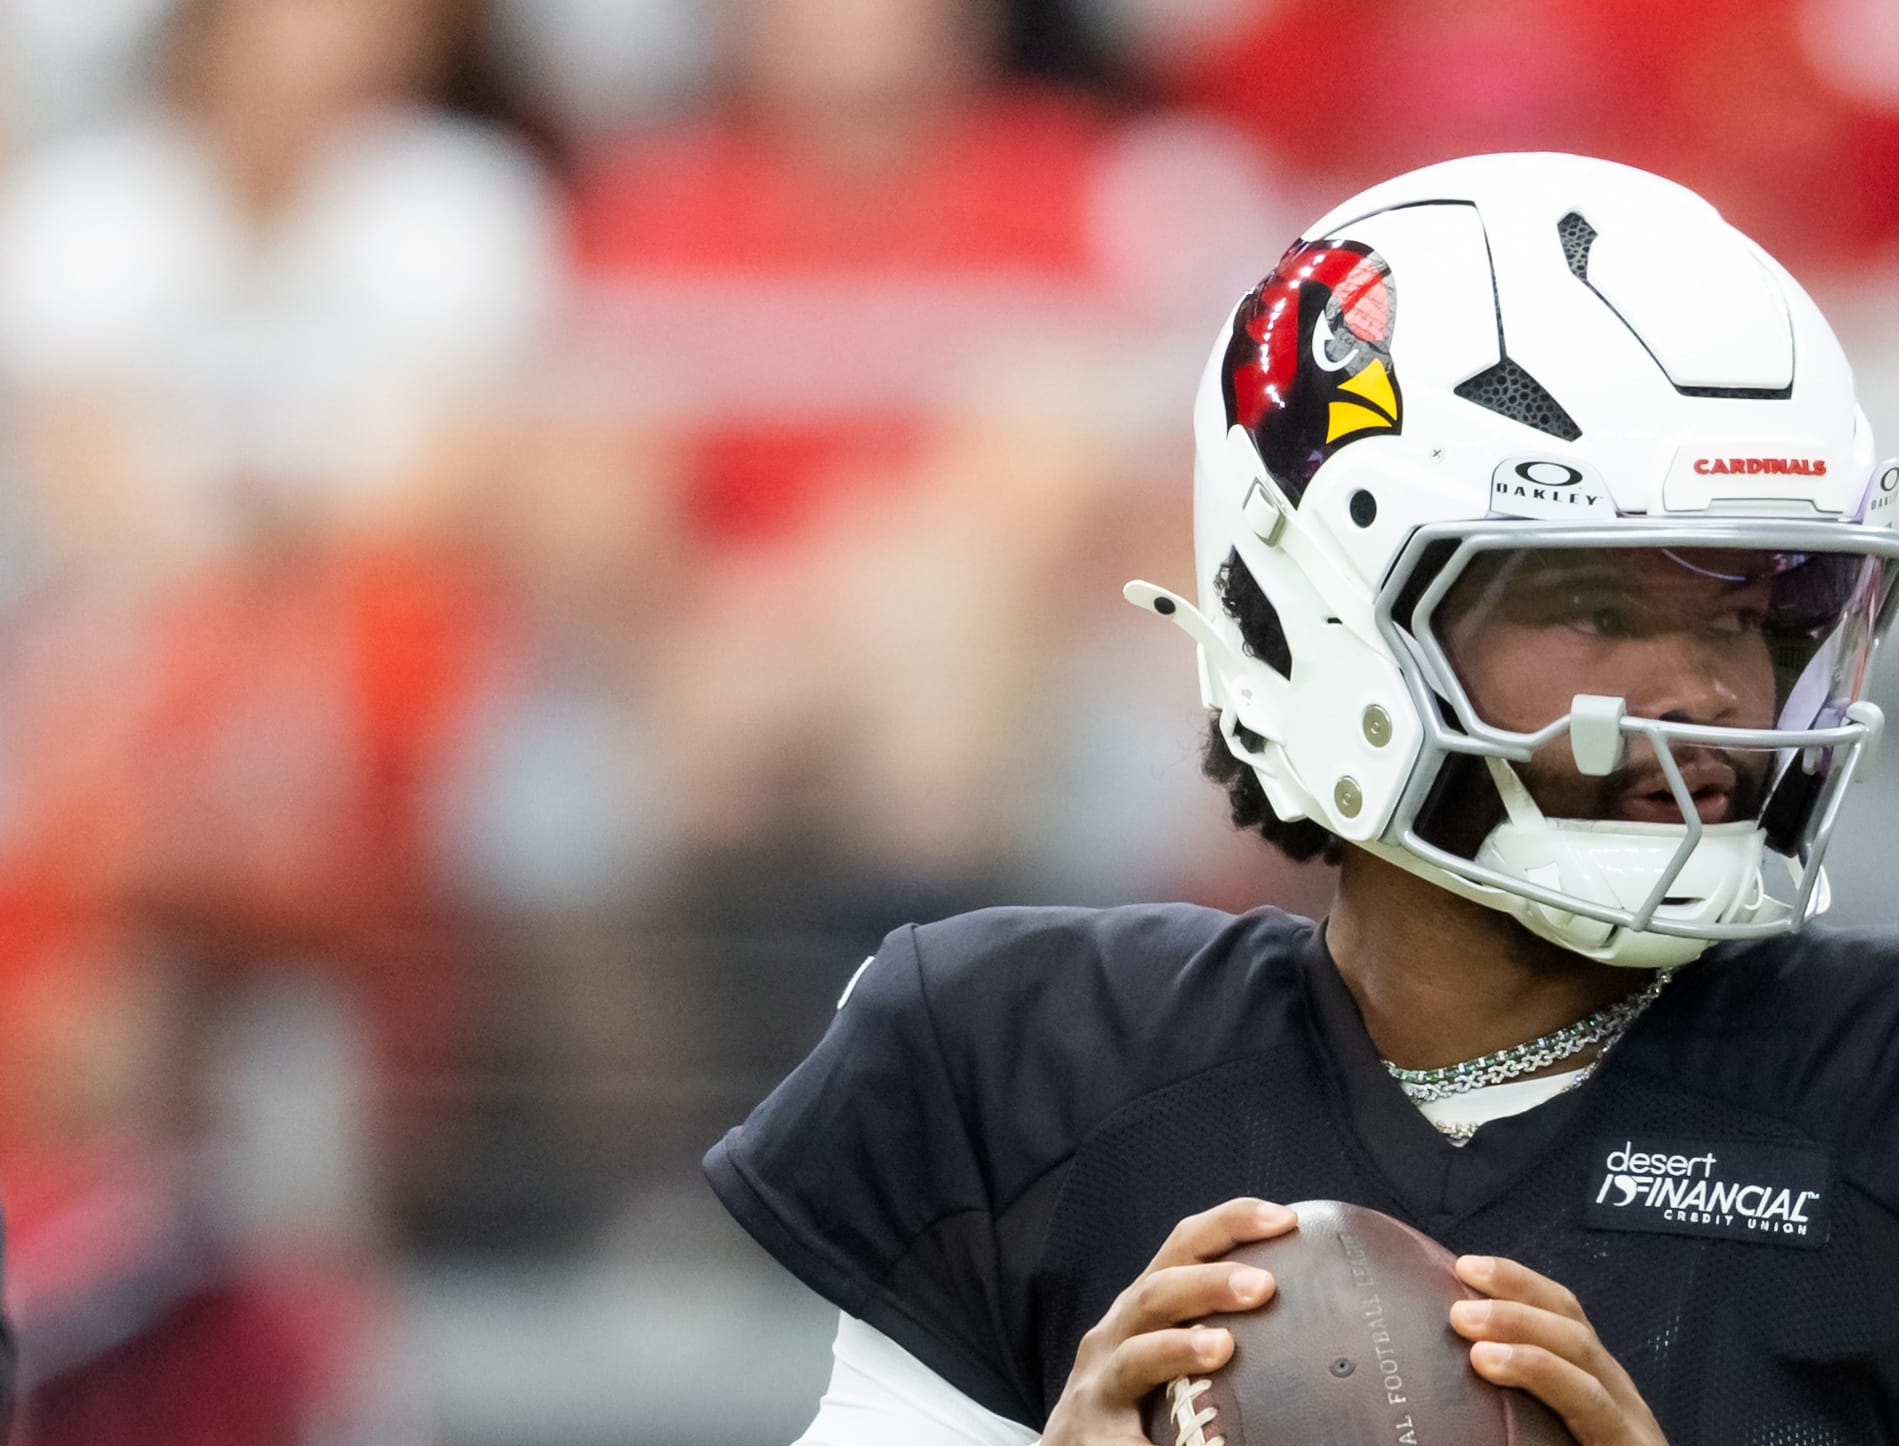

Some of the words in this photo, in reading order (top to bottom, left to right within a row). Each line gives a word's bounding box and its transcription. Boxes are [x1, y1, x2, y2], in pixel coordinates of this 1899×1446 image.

[1693, 458, 1827, 476] CARDINALS
[1496, 482, 1598, 506] OAKLEY
[1606, 1141, 1717, 1178] desert
[1663, 1209, 1734, 1226] CREDIT
[1747, 1218, 1808, 1236] UNION
[1364, 1293, 1407, 1405] FOOTBALL
